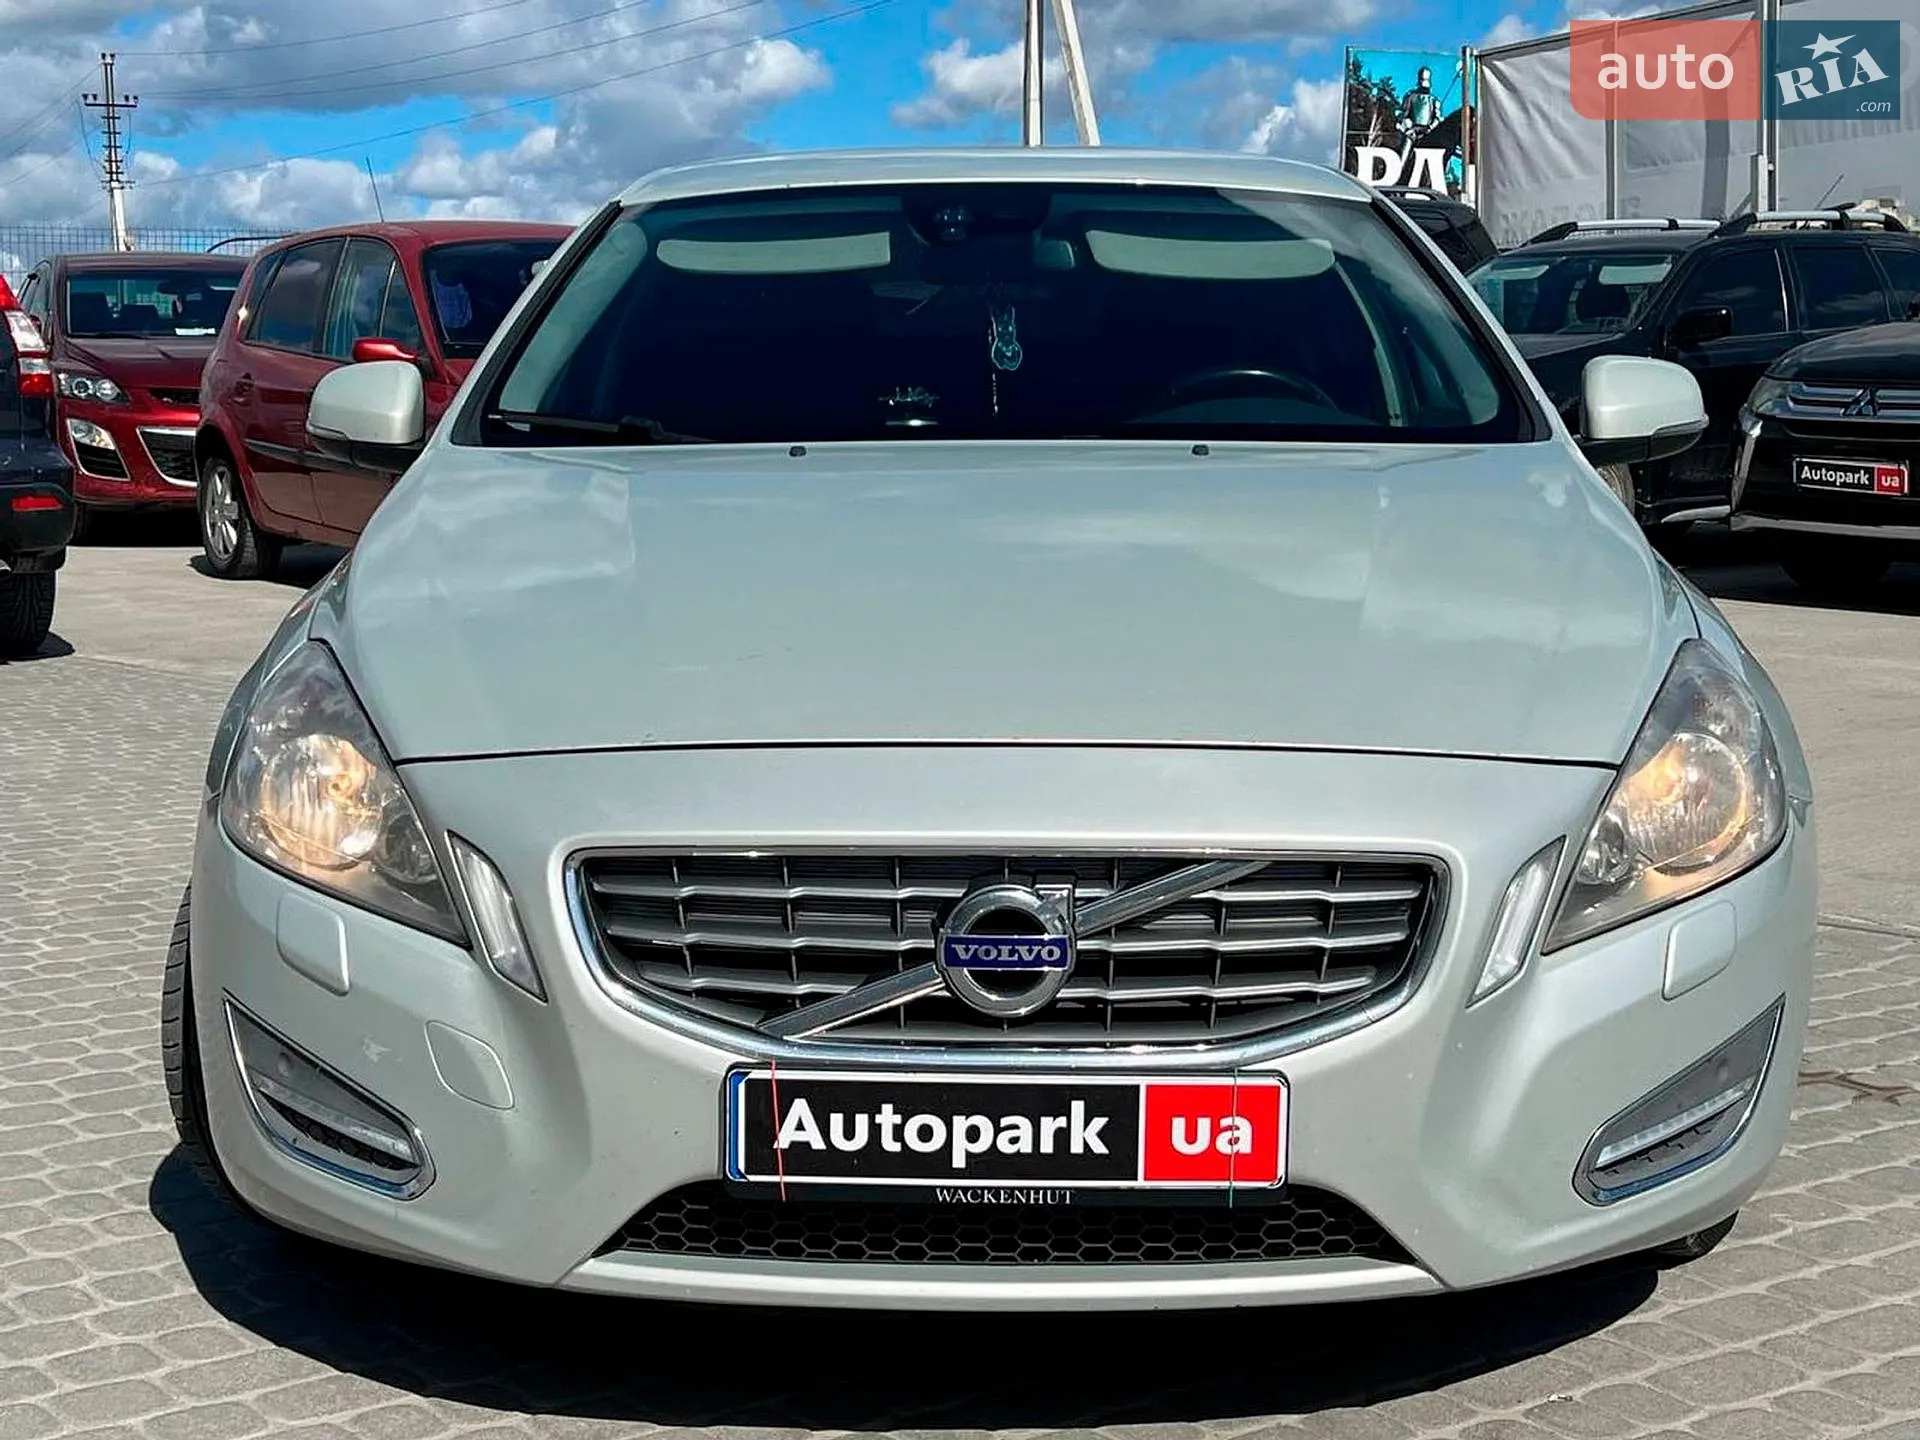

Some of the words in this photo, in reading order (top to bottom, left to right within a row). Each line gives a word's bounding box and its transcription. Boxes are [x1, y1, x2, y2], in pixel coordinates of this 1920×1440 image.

[1801, 465, 1869, 486] Autopark
[1881, 473, 1900, 487] ua
[951, 944, 1061, 961] VOLVO
[773, 1098, 1110, 1169] Autopark
[1170, 1115, 1253, 1155] ua
[935, 1187, 1076, 1205] WACKENHUT
